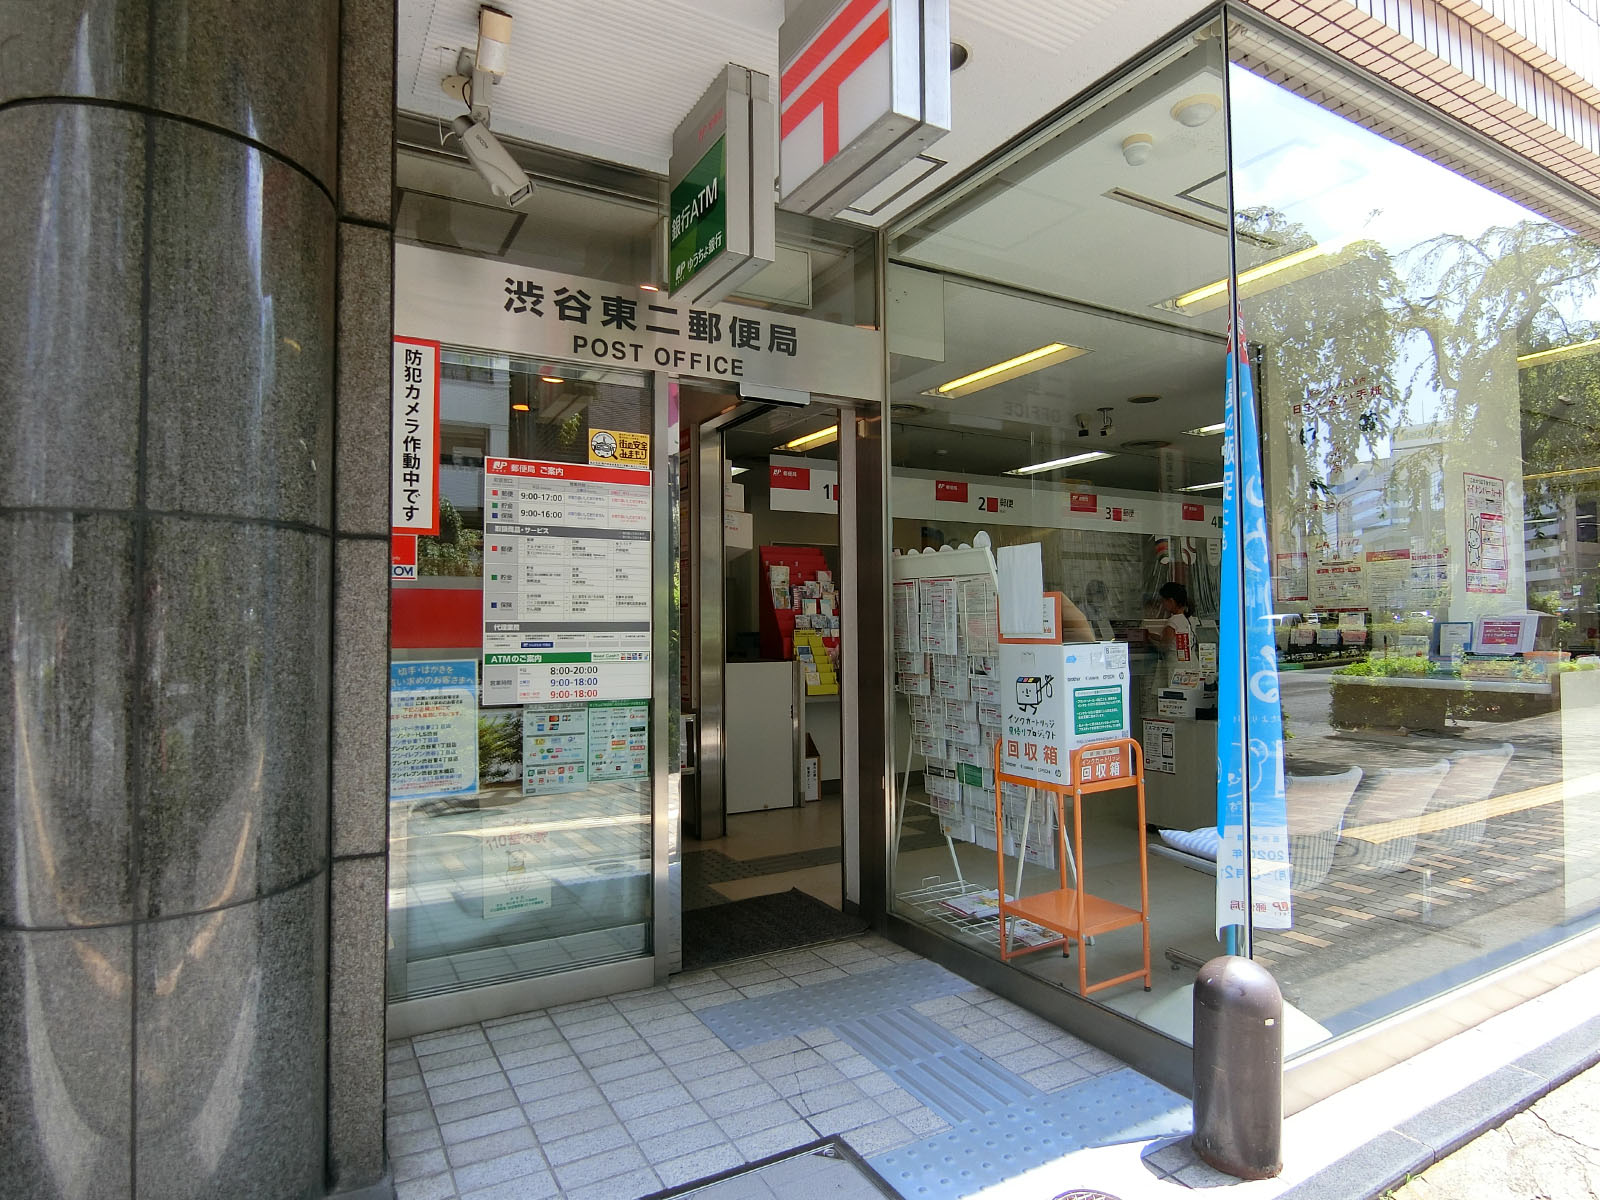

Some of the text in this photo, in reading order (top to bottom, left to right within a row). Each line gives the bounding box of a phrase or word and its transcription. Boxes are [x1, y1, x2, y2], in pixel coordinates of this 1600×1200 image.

[671, 177, 718, 242] 銀行ATM
[687, 231, 722, 270] ゆうちょ銀行
[504, 277, 798, 357] 渋谷東二郵便局
[573, 335, 744, 377] POST OFFICE
[402, 349, 423, 521] 防犯カメラ作動中です
[510, 464, 536, 474] 郵便局
[539, 466, 564, 476] ご案内
[520, 492, 563, 502] 9:00-17:00
[823, 484, 830, 500] 1
[978, 497, 986, 511] 2
[520, 509, 563, 519] 9:00-16:00
[1105, 507, 1112, 520] 3
[1210, 515, 1218, 528] 4
[491, 655, 542, 663] ATMのご案内
[550, 666, 598, 675] 8:00-20:00
[550, 677, 598, 687] 9:00-18:00
[550, 690, 598, 699] 9:00-18:00
[1008, 714, 1055, 728] インクカートリッジ
[1008, 740, 1058, 766] 回収箱
[1081, 761, 1120, 780] 回収箱
